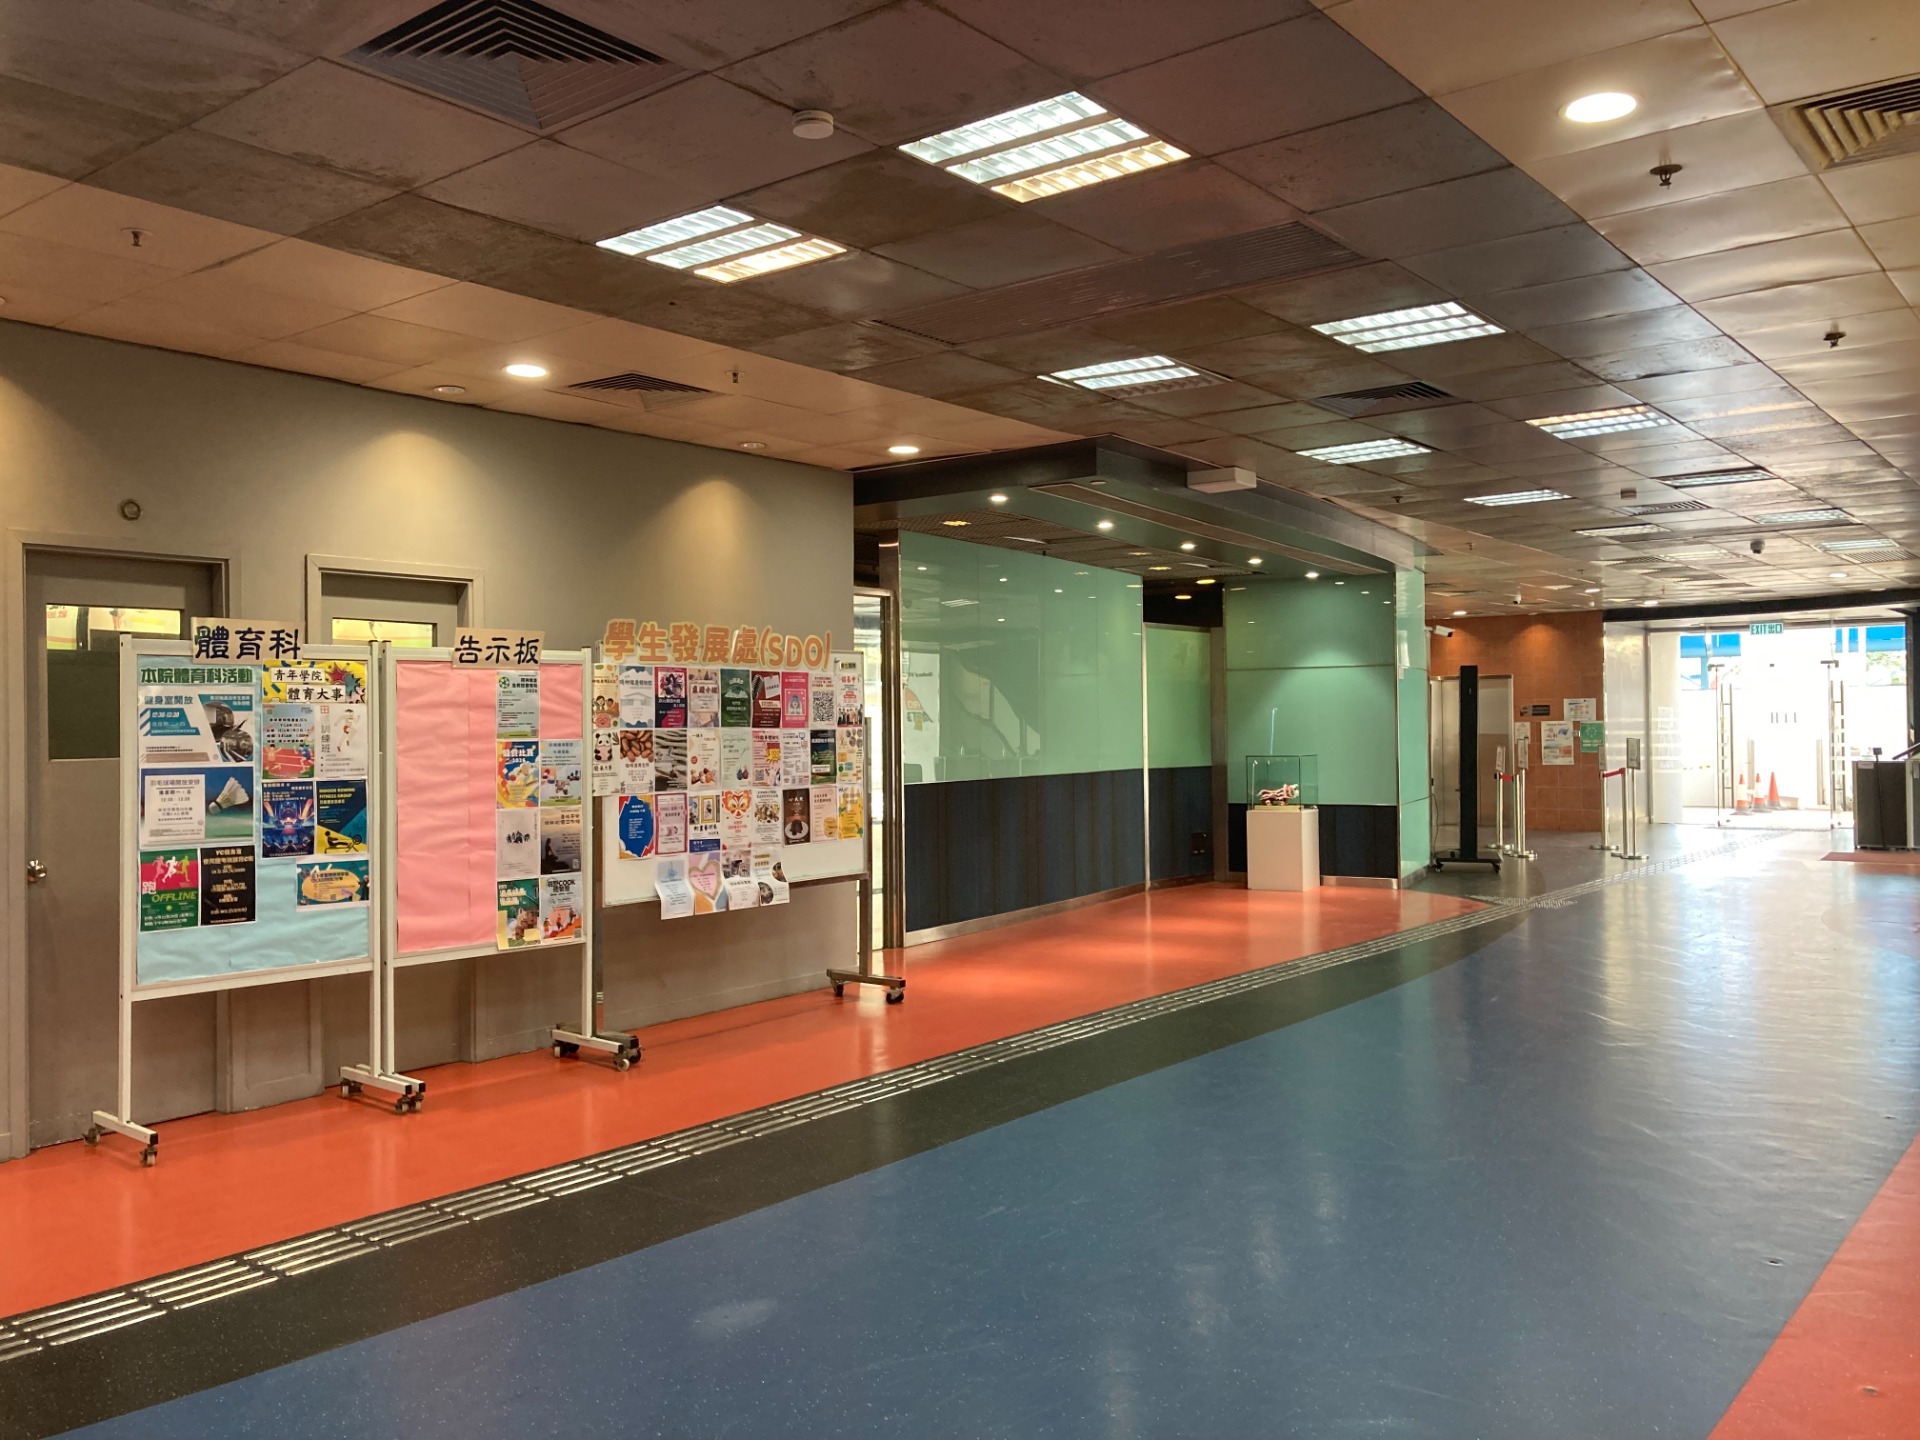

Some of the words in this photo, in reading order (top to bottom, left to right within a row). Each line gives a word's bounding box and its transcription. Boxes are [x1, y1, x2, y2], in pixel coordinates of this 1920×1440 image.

[1751, 624, 1767, 635] EXIT
[1768, 623, 1782, 634] 出口
[194, 625, 301, 660] 體育科
[455, 635, 539, 664] 告示板
[604, 619, 832, 671] 學生發展處(SDO)
[140, 667, 253, 684] 本院體育科活動
[274, 668, 323, 682] 青年學院
[287, 686, 345, 701] 體育大事
[151, 890, 198, 903] OFFLINE
